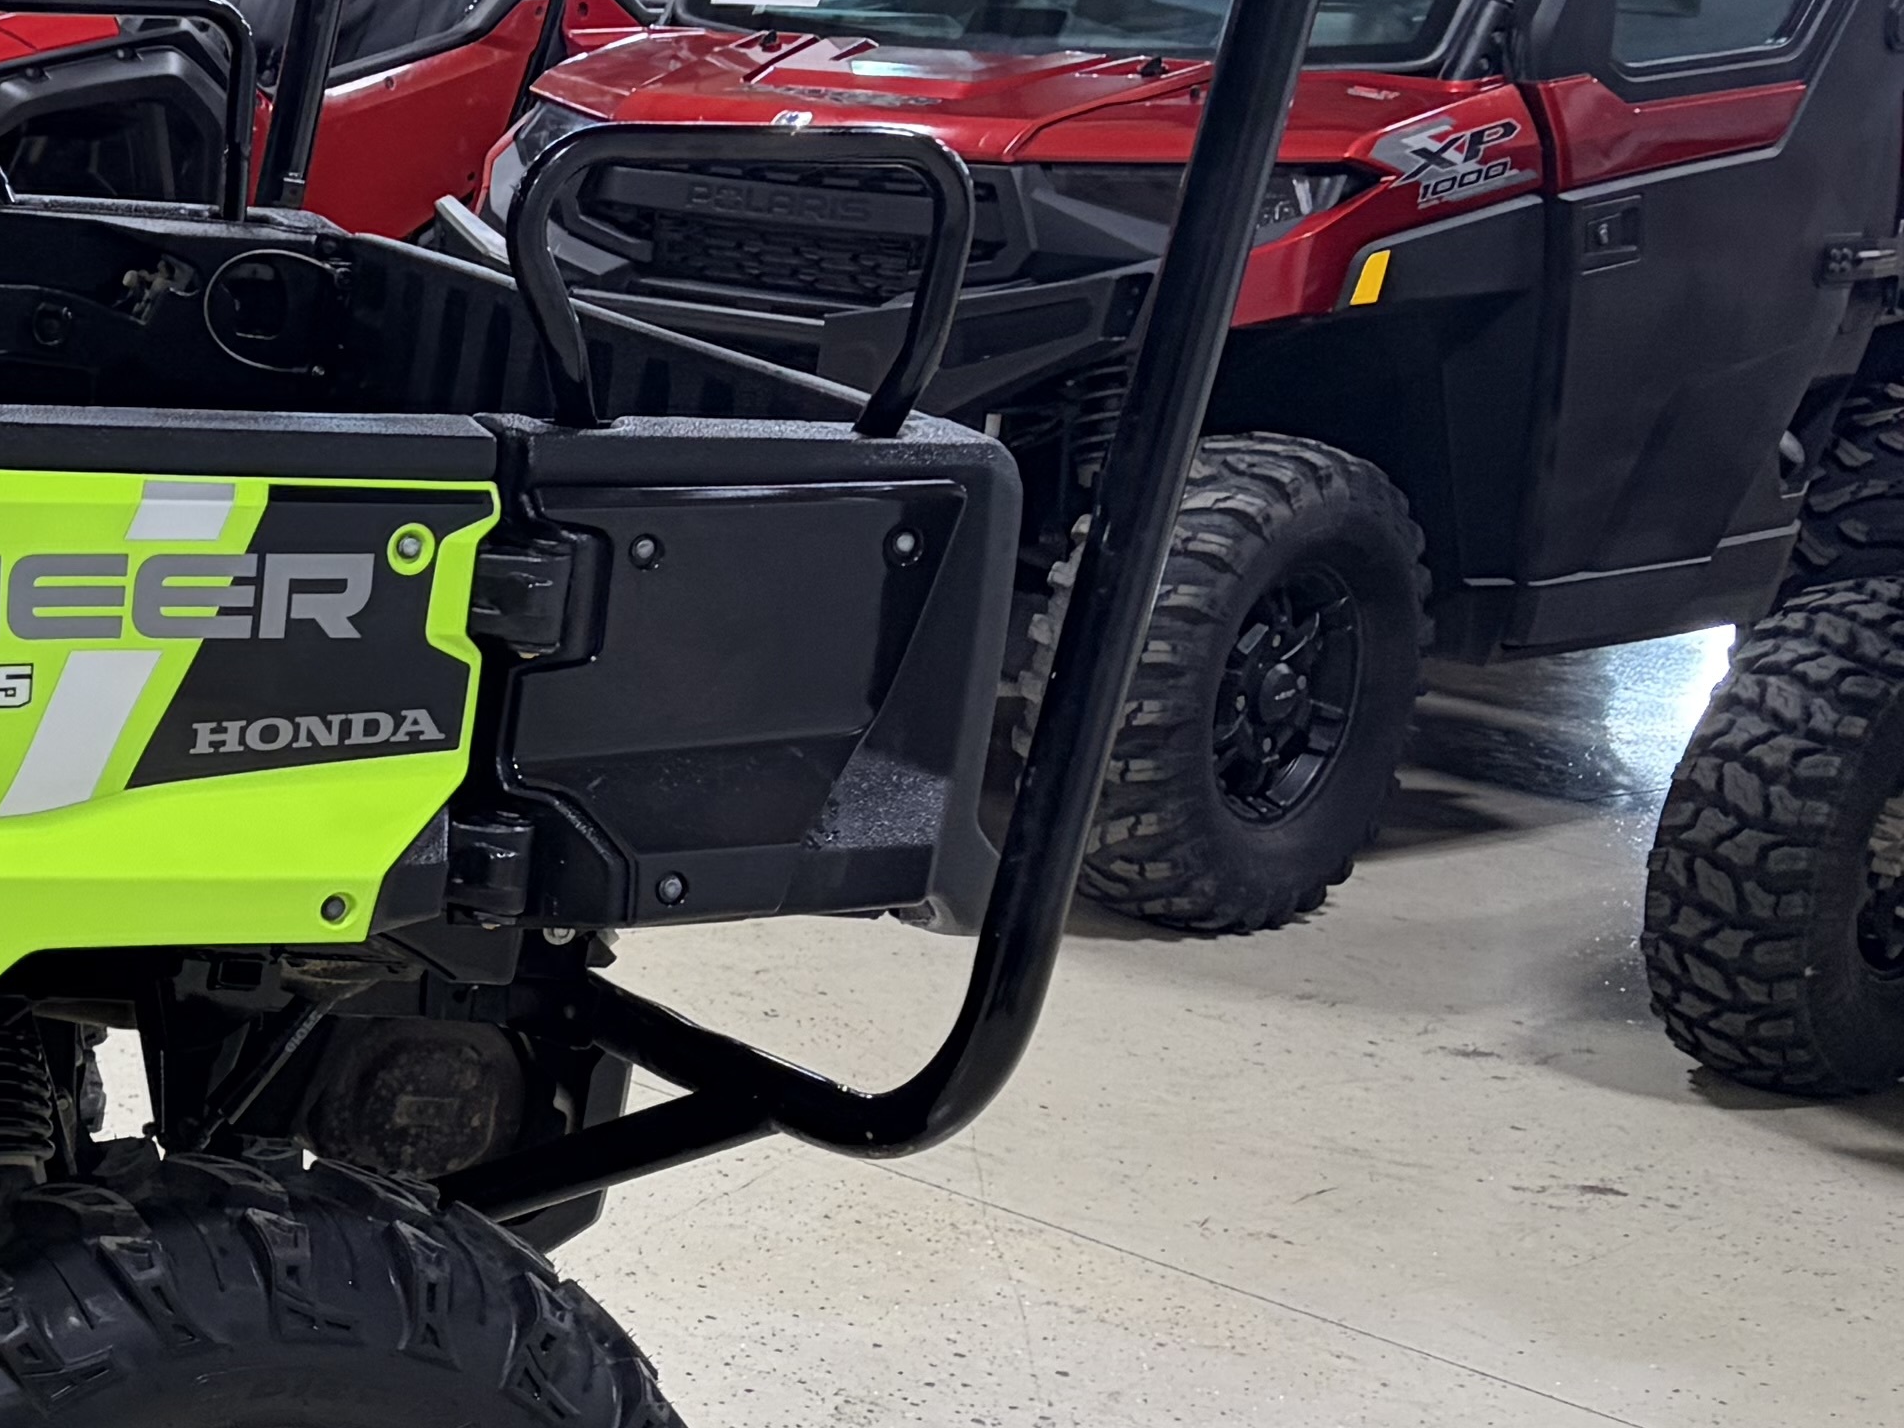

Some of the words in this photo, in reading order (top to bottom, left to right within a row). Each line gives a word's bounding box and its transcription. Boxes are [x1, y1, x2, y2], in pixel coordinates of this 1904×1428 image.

[1391, 118, 1521, 187] XP
[687, 181, 872, 223] POLARIS
[1420, 157, 1511, 202] 1000
[188, 708, 446, 756] HONDA
